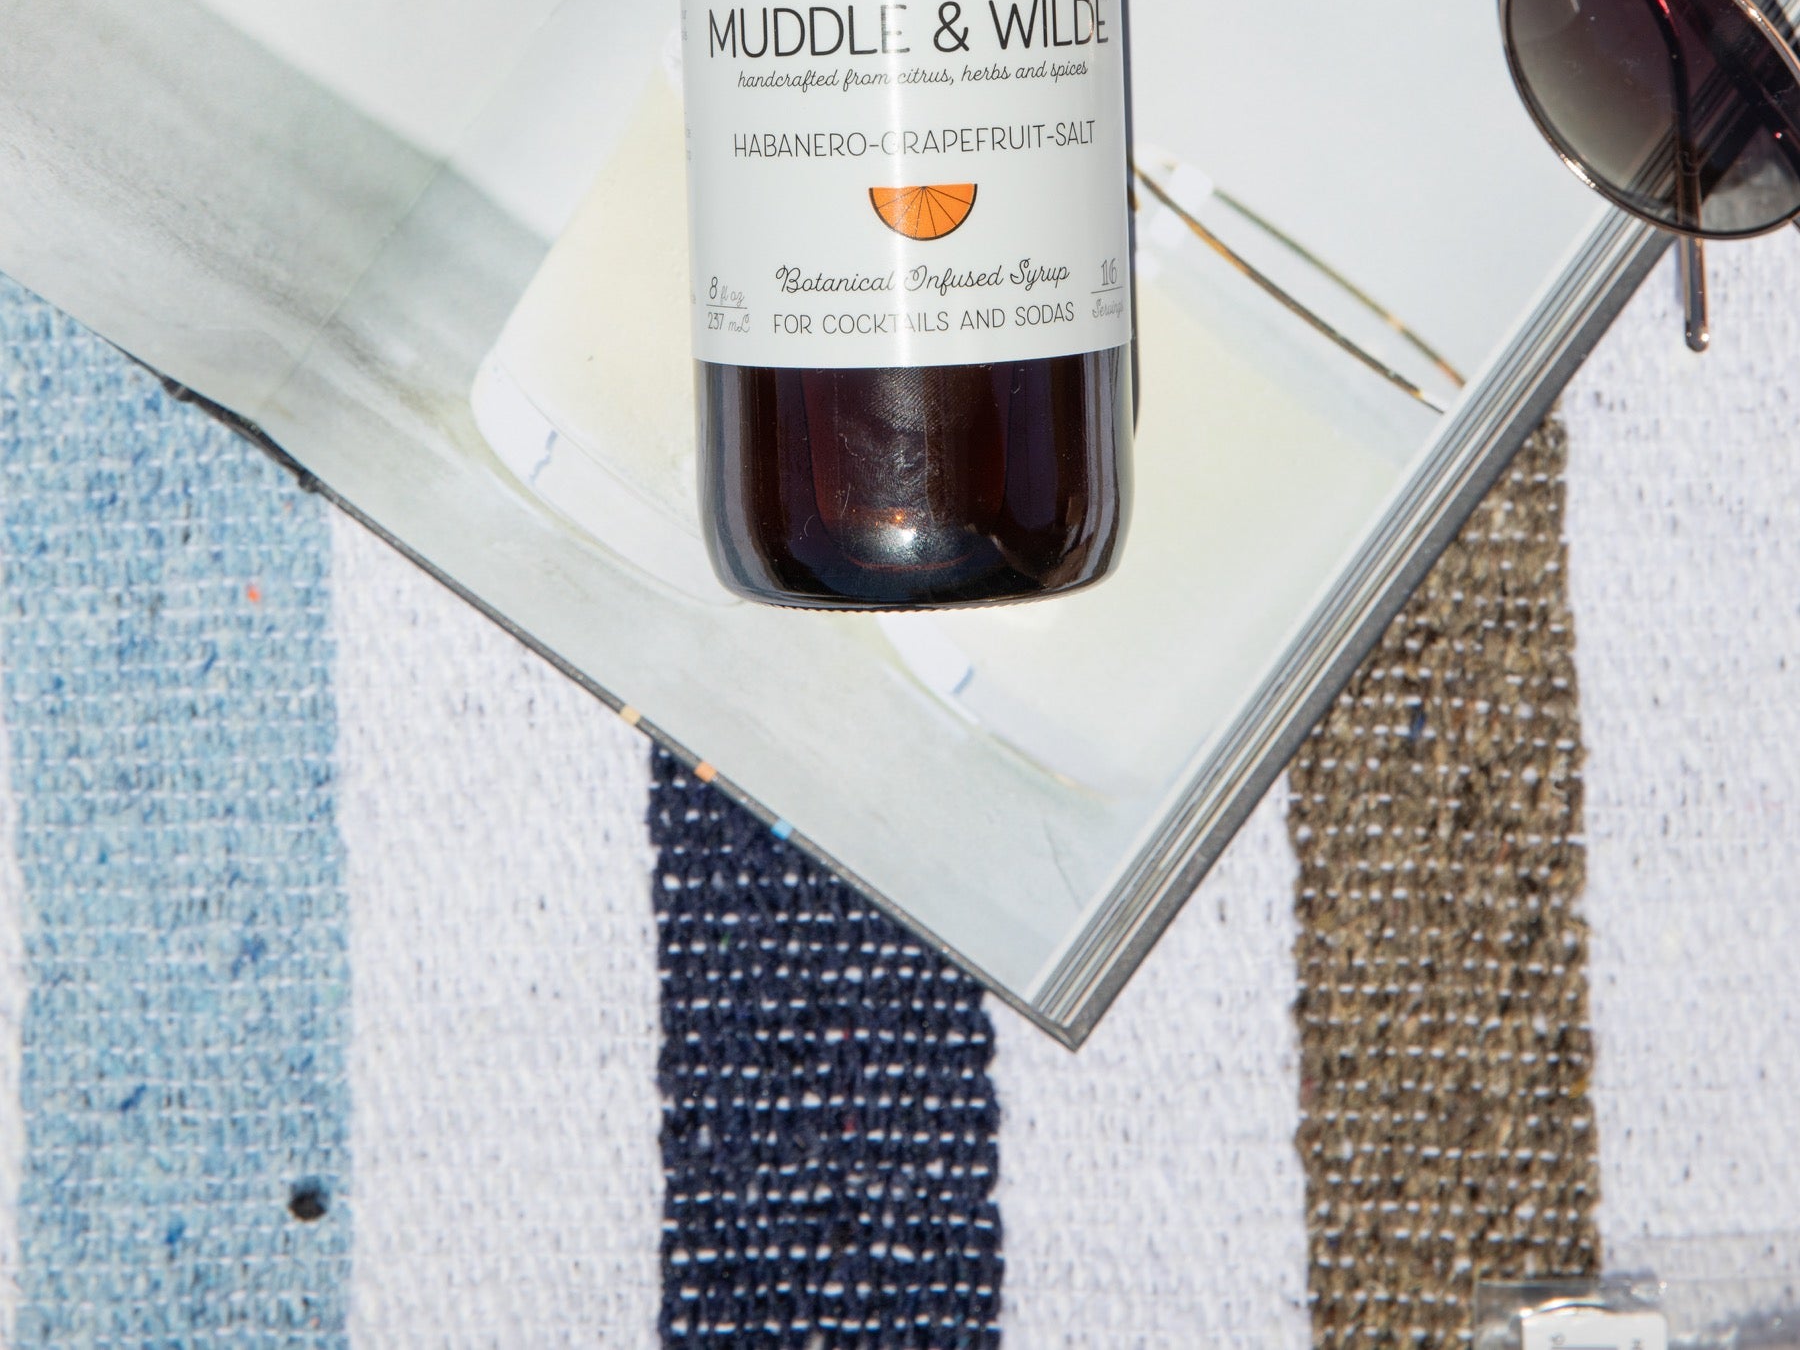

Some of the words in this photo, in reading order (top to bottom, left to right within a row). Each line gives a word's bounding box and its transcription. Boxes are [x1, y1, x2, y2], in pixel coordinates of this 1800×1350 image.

[708, 4, 911, 59] MUDDLE
[933, 1, 970, 53] &
[737, 69, 839, 93] handcrafted
[842, 68, 891, 92] from
[897, 67, 954, 86] citrus,
[961, 62, 1011, 82] herbs
[1015, 60, 1048, 80] and
[1050, 60, 1089, 84] spices
[709, 276, 719, 300] 8
[775, 264, 897, 293] Botanical
[904, 264, 1004, 297] Infused
[1010, 257, 1071, 291] Syrup
[1101, 257, 1118, 286] 16
[707, 311, 725, 331] 237
[773, 313, 813, 334] FOR
[822, 310, 950, 334] COCKTAILS
[960, 308, 1006, 331] AND
[1014, 301, 1075, 327] SODAS
